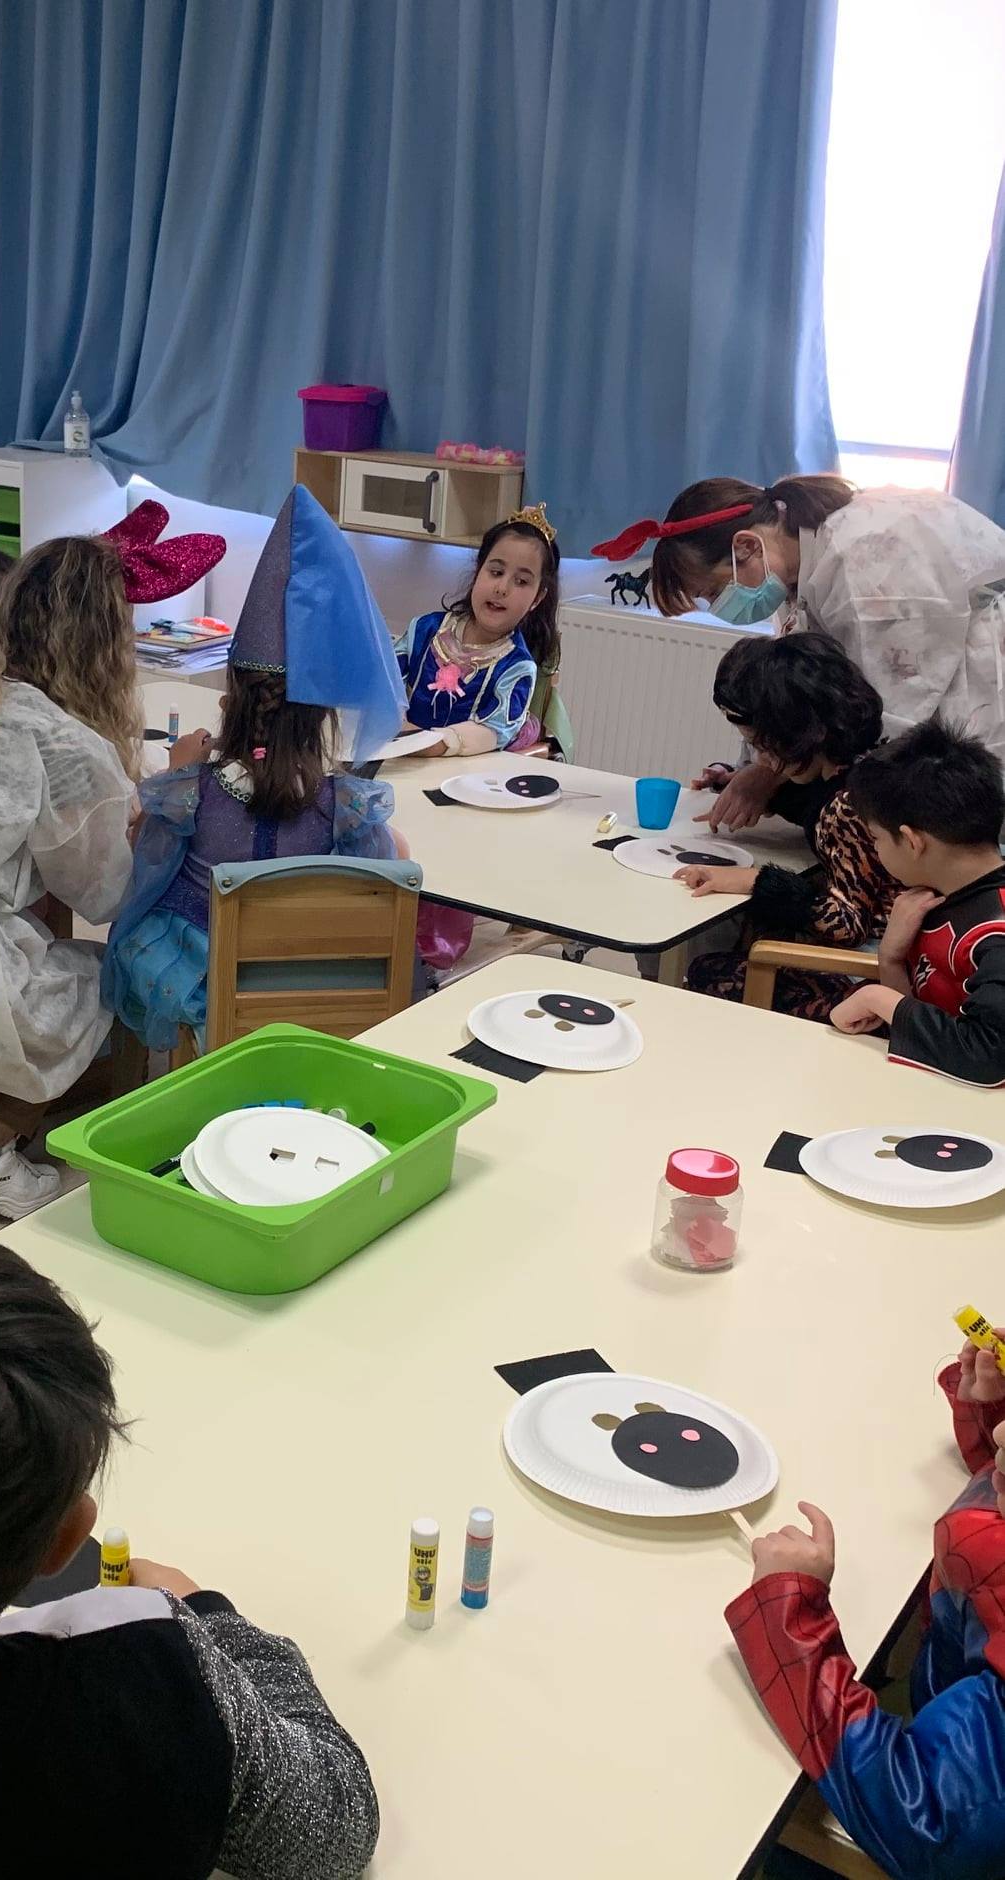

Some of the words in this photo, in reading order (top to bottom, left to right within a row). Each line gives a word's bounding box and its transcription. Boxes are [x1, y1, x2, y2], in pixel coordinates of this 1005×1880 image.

[969, 1315, 987, 1333] UHU
[414, 1547, 436, 1559] UHU
[101, 1560, 124, 1573] UHU
